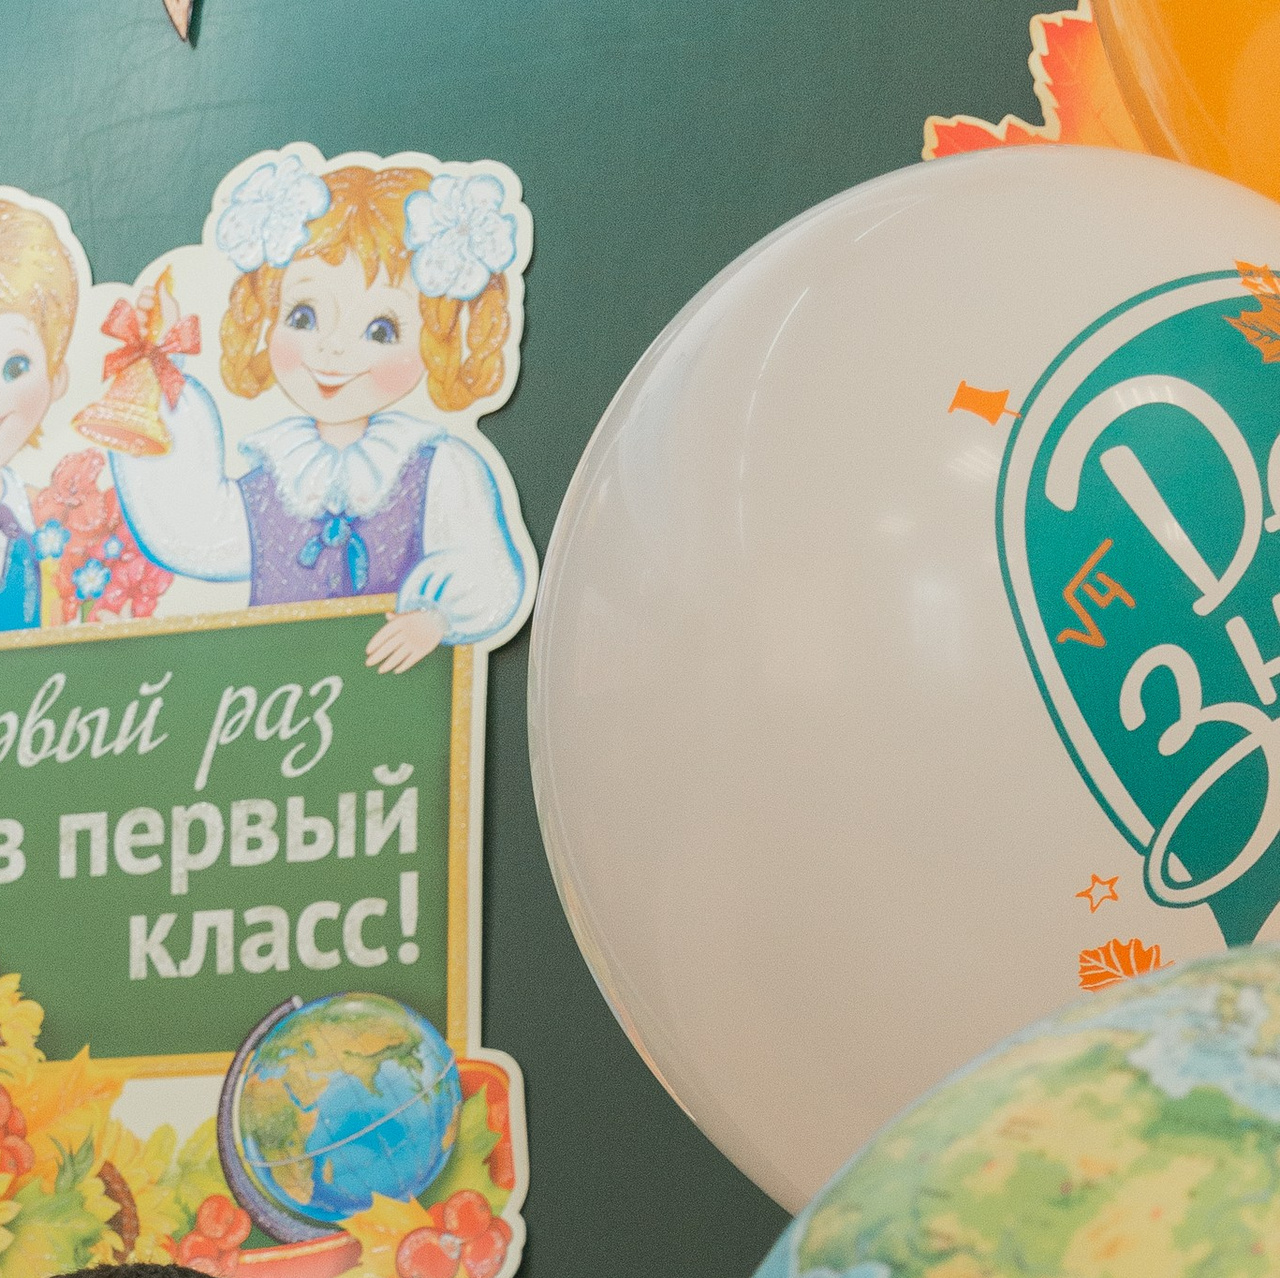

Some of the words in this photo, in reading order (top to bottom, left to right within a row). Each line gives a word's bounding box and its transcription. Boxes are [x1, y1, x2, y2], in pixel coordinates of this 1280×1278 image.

[194, 674, 344, 792] раз
[58, 762, 420, 895] первый
[129, 870, 422, 981] класс!
